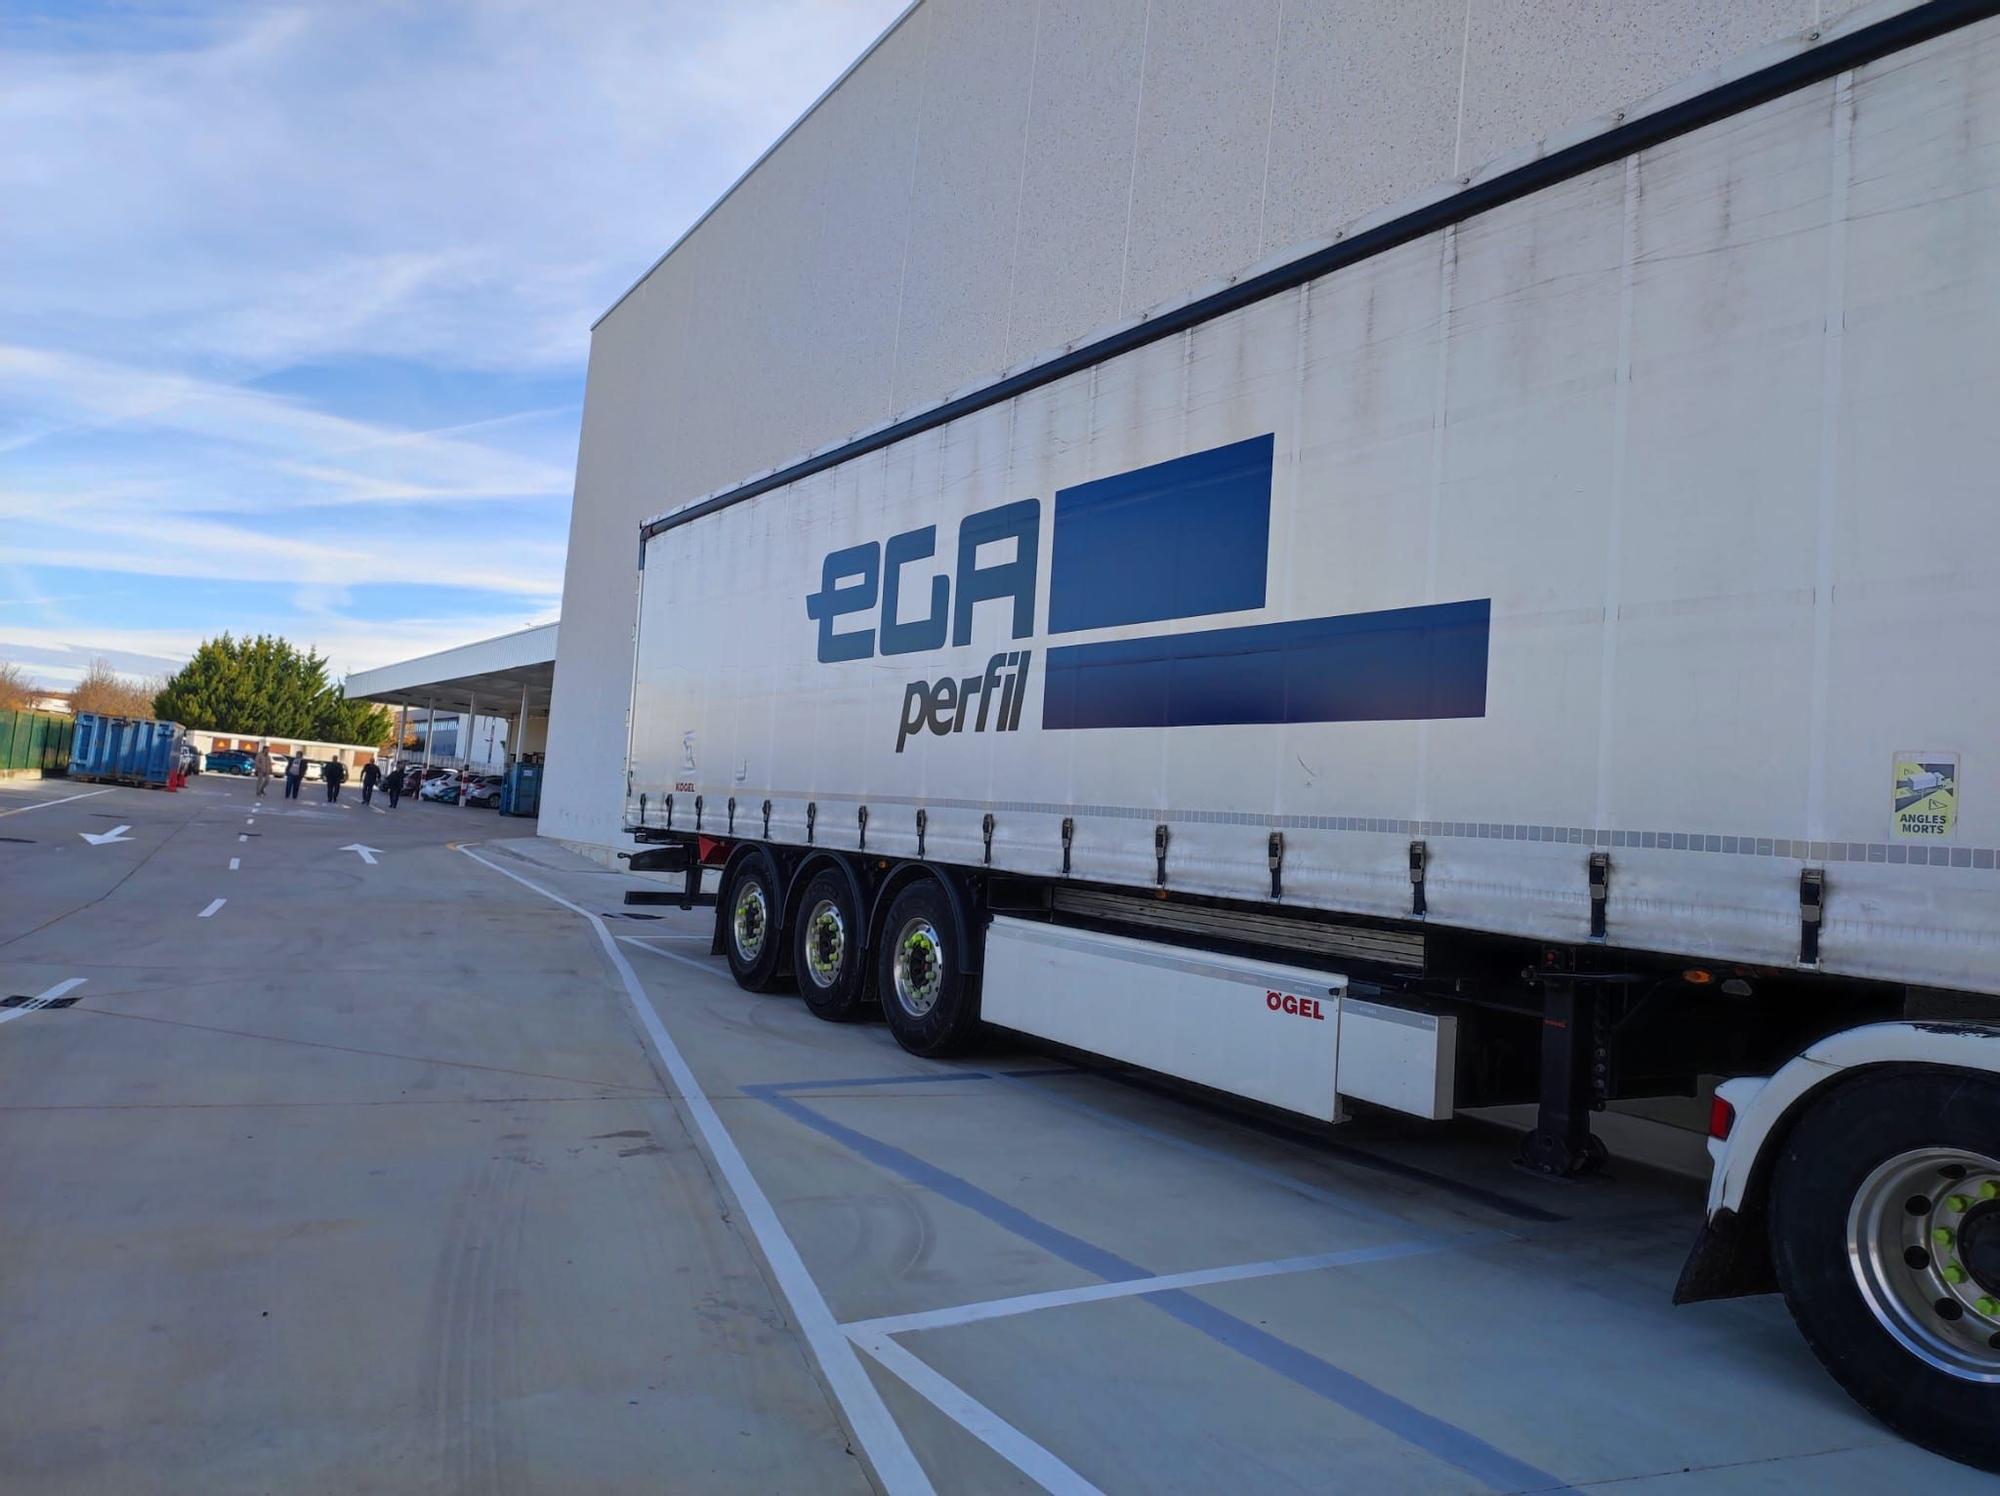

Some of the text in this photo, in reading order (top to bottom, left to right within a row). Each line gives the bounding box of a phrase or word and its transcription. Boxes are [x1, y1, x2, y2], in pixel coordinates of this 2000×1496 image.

[895, 649, 1032, 753] perfil
[1900, 813, 1947, 825] ANGLES
[1902, 824, 1945, 834] MORTS
